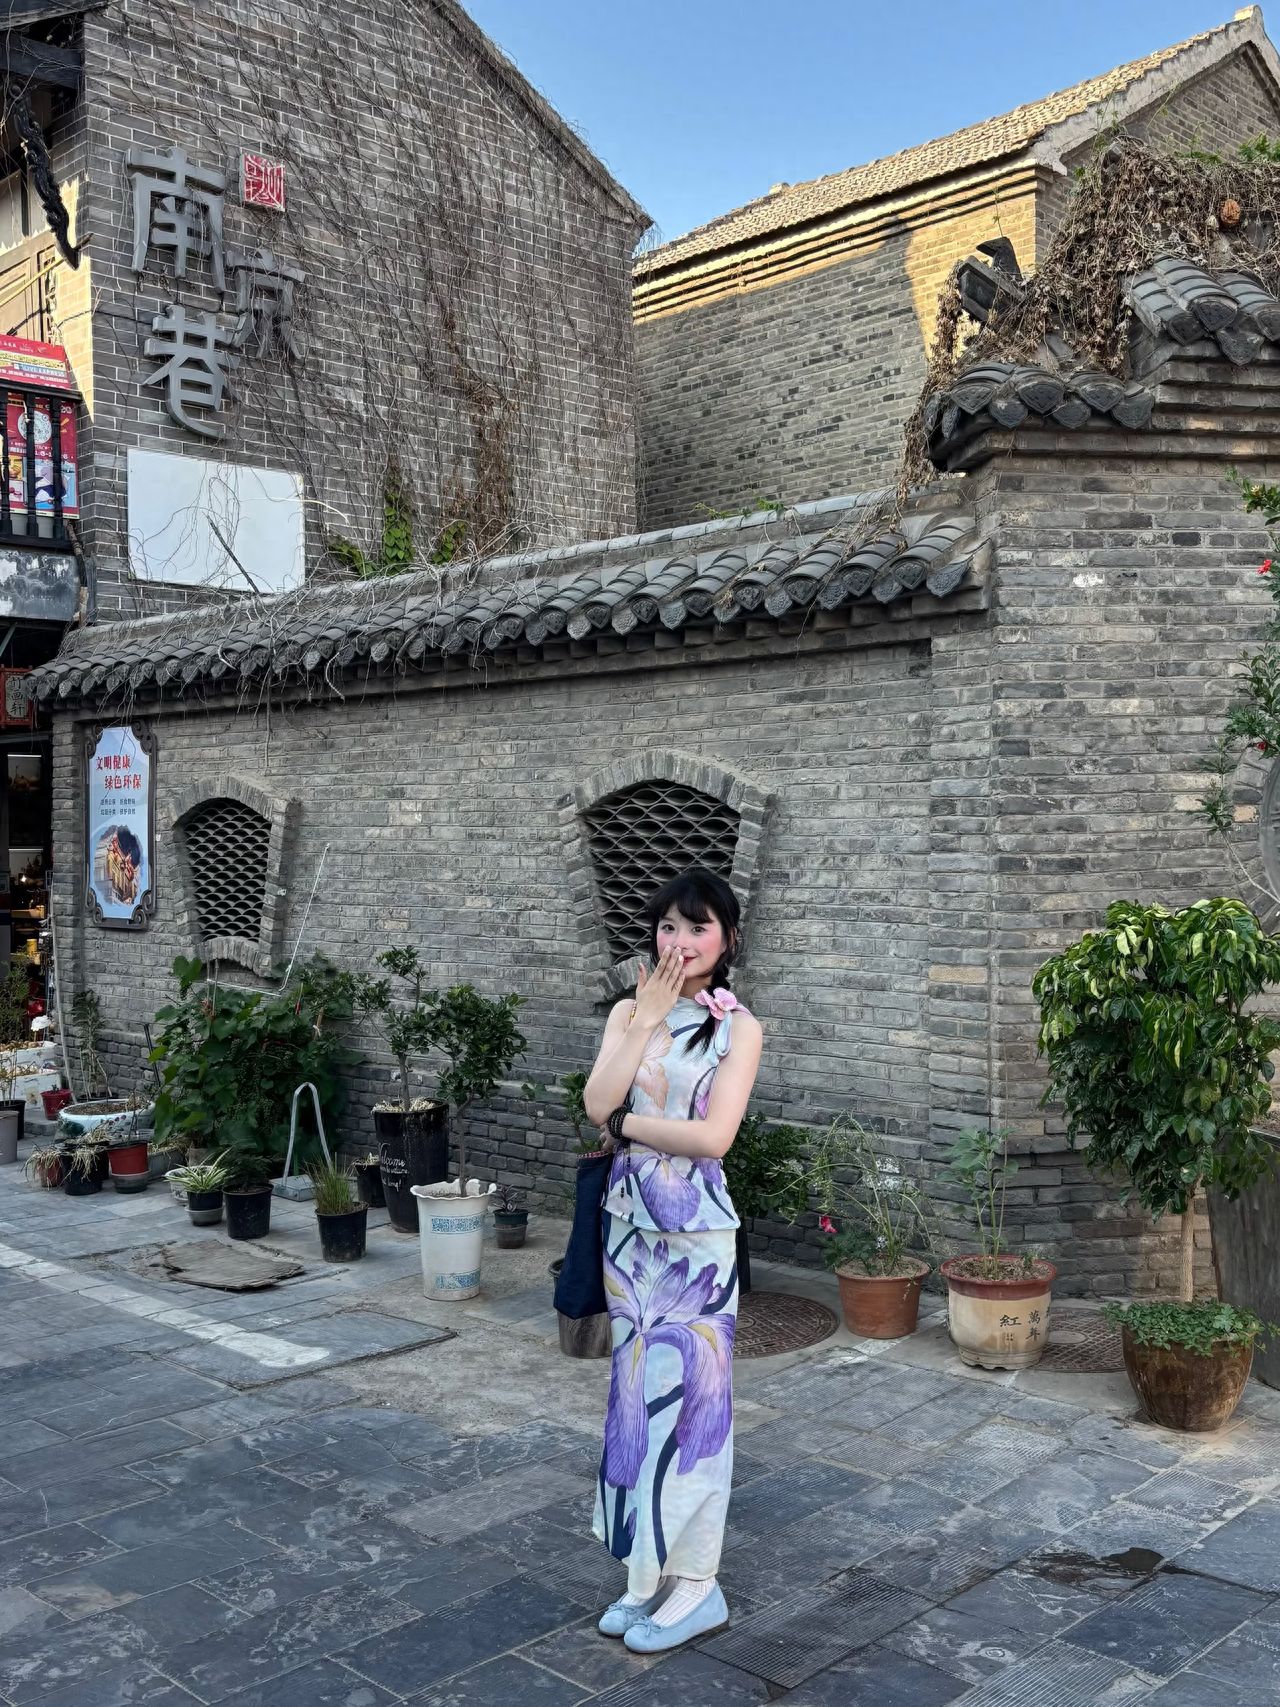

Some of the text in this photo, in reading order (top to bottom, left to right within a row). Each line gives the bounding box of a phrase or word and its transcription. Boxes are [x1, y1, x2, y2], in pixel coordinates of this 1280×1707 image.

[96, 754, 131, 771] 文明健康
[104, 773, 142, 790] 绿色环保
